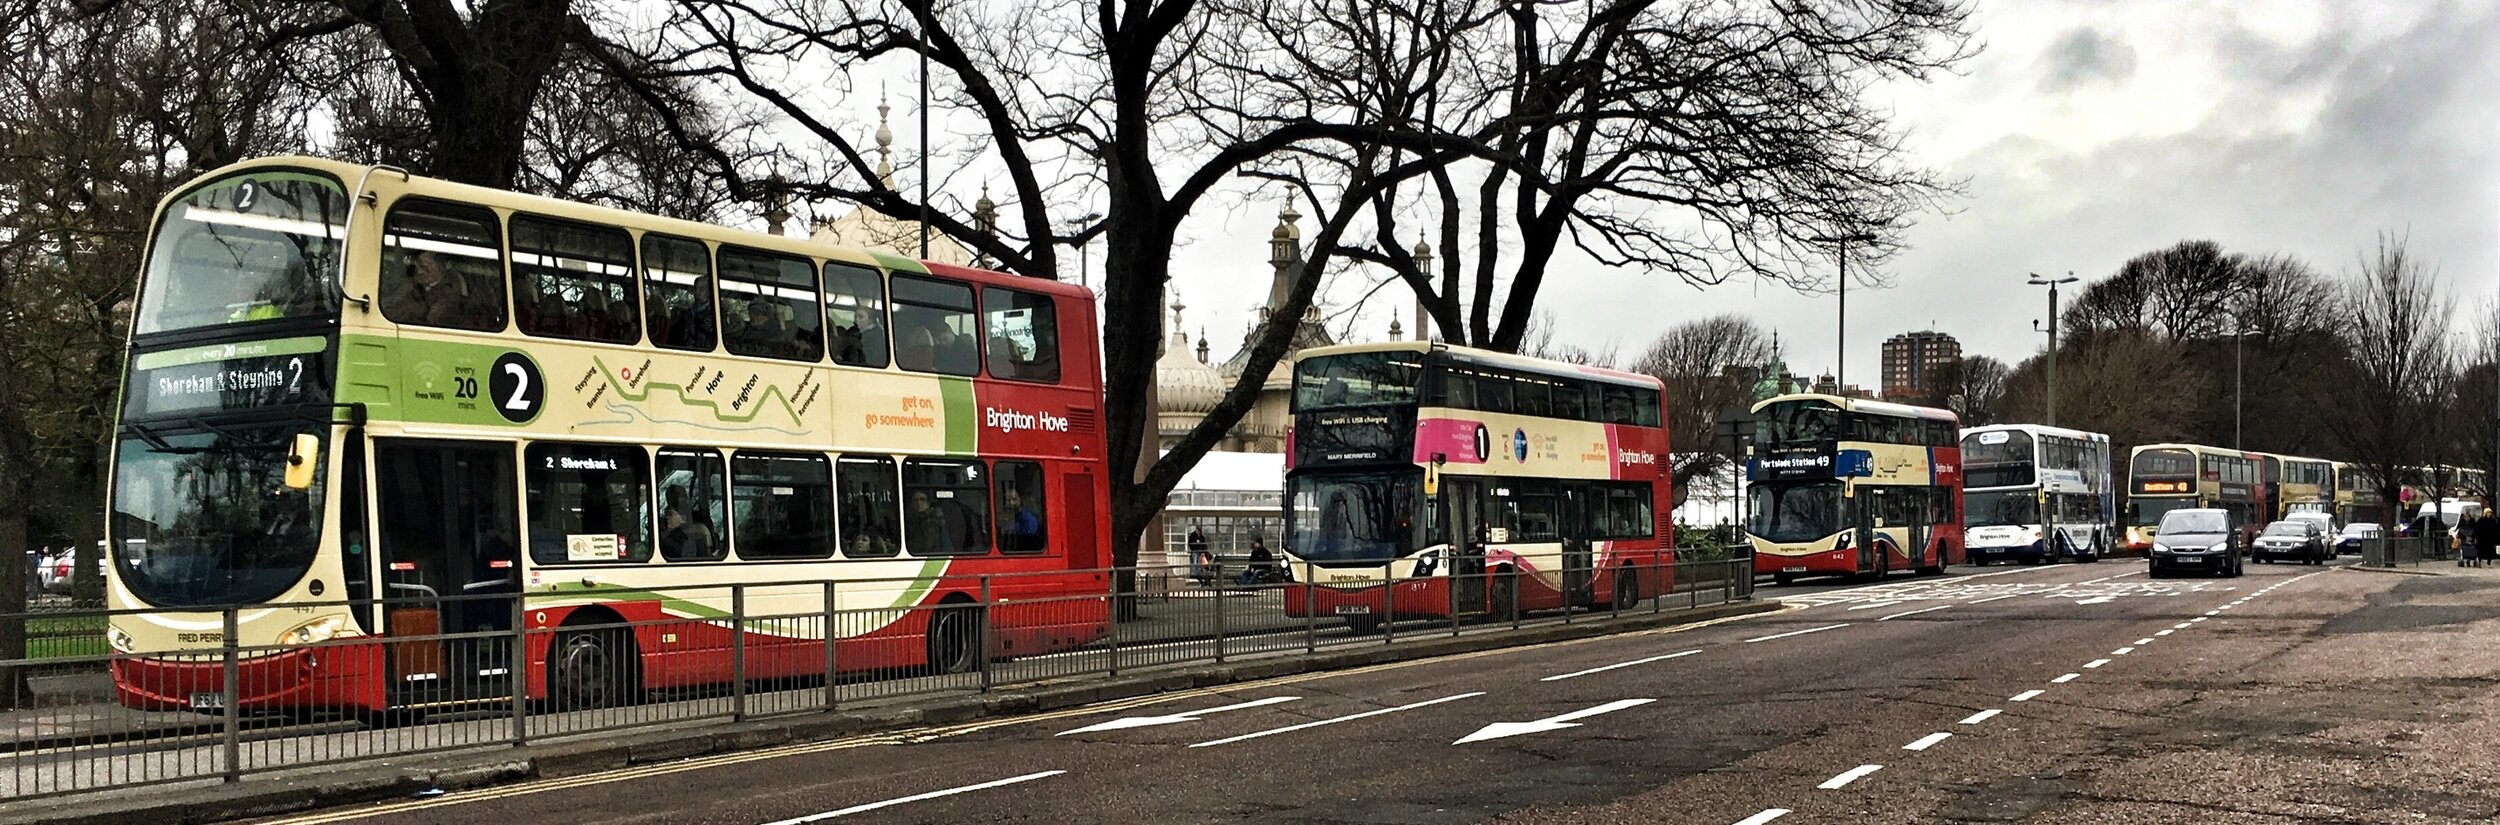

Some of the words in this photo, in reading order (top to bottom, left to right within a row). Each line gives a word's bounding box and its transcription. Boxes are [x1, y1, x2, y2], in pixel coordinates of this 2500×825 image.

[238, 183, 253, 208] 2
[202, 350, 223, 361] every
[223, 344, 236, 357] 20
[159, 374, 213, 397] Shoreham
[217, 371, 226, 392] &
[229, 367, 283, 390] Steyning
[289, 356, 303, 394] 2
[455, 366, 475, 376] every
[575, 366, 597, 394] Steyning
[629, 358, 651, 389] Shoreham
[685, 365, 706, 393] Portslade
[454, 377, 478, 399] 20
[504, 362, 531, 410] 2
[705, 370, 724, 395] Hove
[731, 373, 759, 411] Brighton
[415, 391, 429, 400] free
[458, 402, 476, 410] mins
[586, 381, 608, 409] Bramber
[902, 396, 918, 411] get
[919, 398, 934, 410] on,
[865, 413, 878, 430] go
[880, 413, 934, 428] somewhere
[986, 406, 1036, 433] Brighton
[1039, 411, 1068, 432] Hove
[1364, 415, 1388, 425] charging
[1478, 428, 1485, 458] 1
[545, 456, 554, 468] 2
[560, 457, 609, 469] Shoreham
[609, 458, 618, 470] &
[1619, 448, 1640, 467] Brighton
[1641, 450, 1655, 465] Hove
[1761, 459, 1791, 469] Portslade
[1792, 458, 1815, 467] Station
[1816, 455, 1829, 467] 49
[178, 633, 198, 642] FRED
